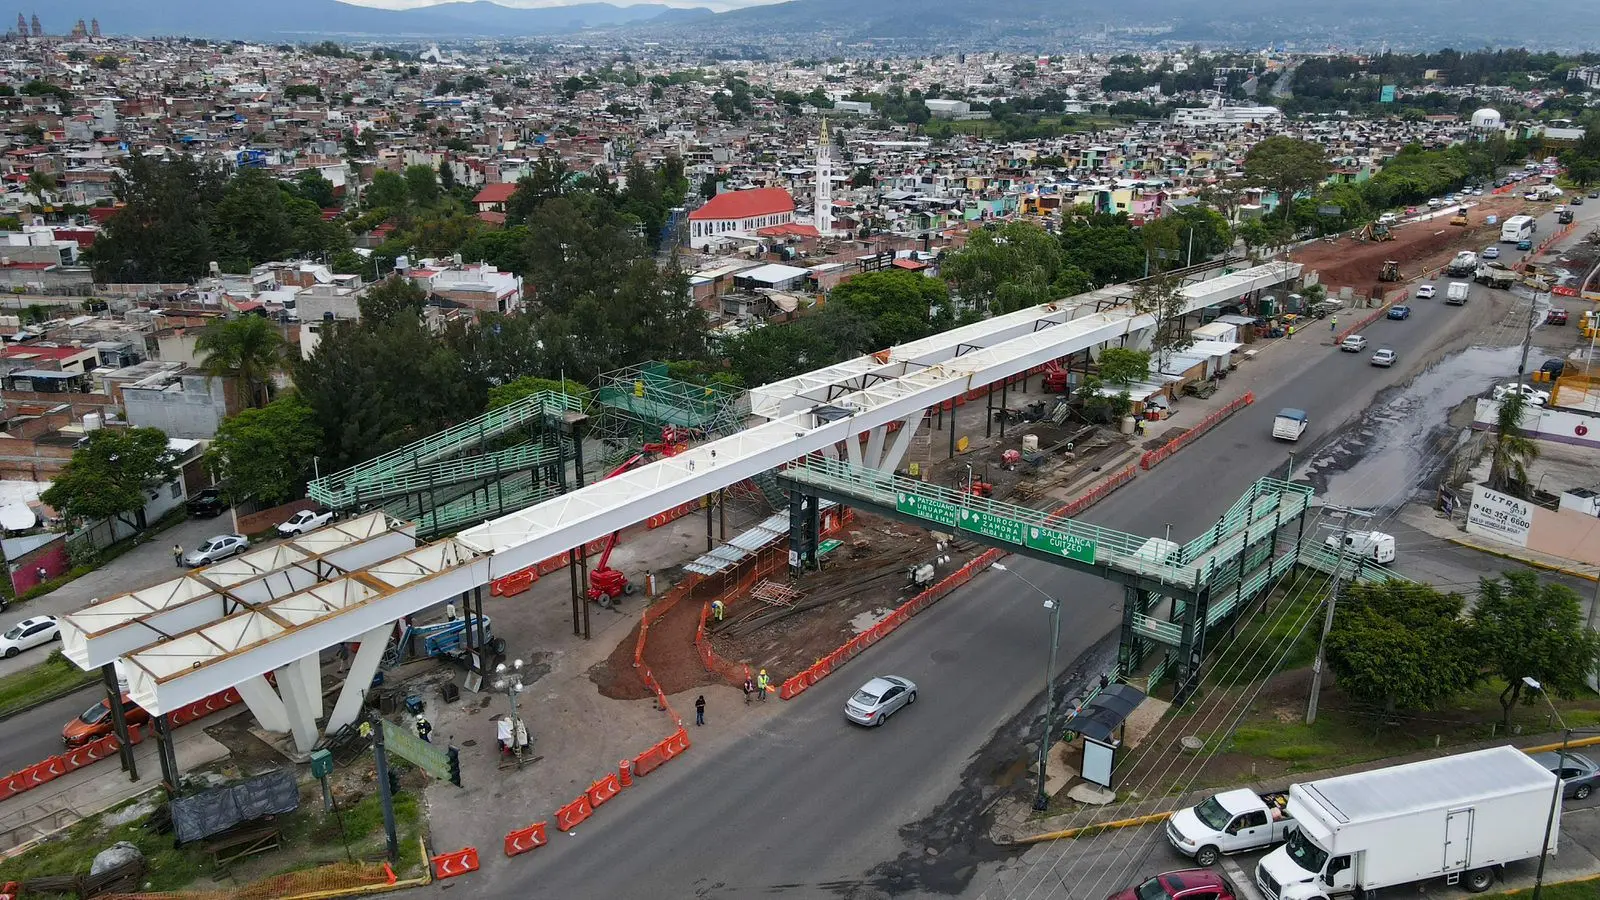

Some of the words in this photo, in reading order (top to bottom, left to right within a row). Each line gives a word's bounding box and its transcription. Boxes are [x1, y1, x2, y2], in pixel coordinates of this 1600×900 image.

[1484, 492, 1520, 509] ULTRA
[917, 503, 954, 518] URUAPAN
[1494, 511, 1508, 521] 324
[982, 513, 1019, 529] QUIROGA
[982, 520, 1018, 535] ZAMORA
[1041, 529, 1091, 548] SALAMANCA
[1049, 538, 1082, 553] CUITZEO
